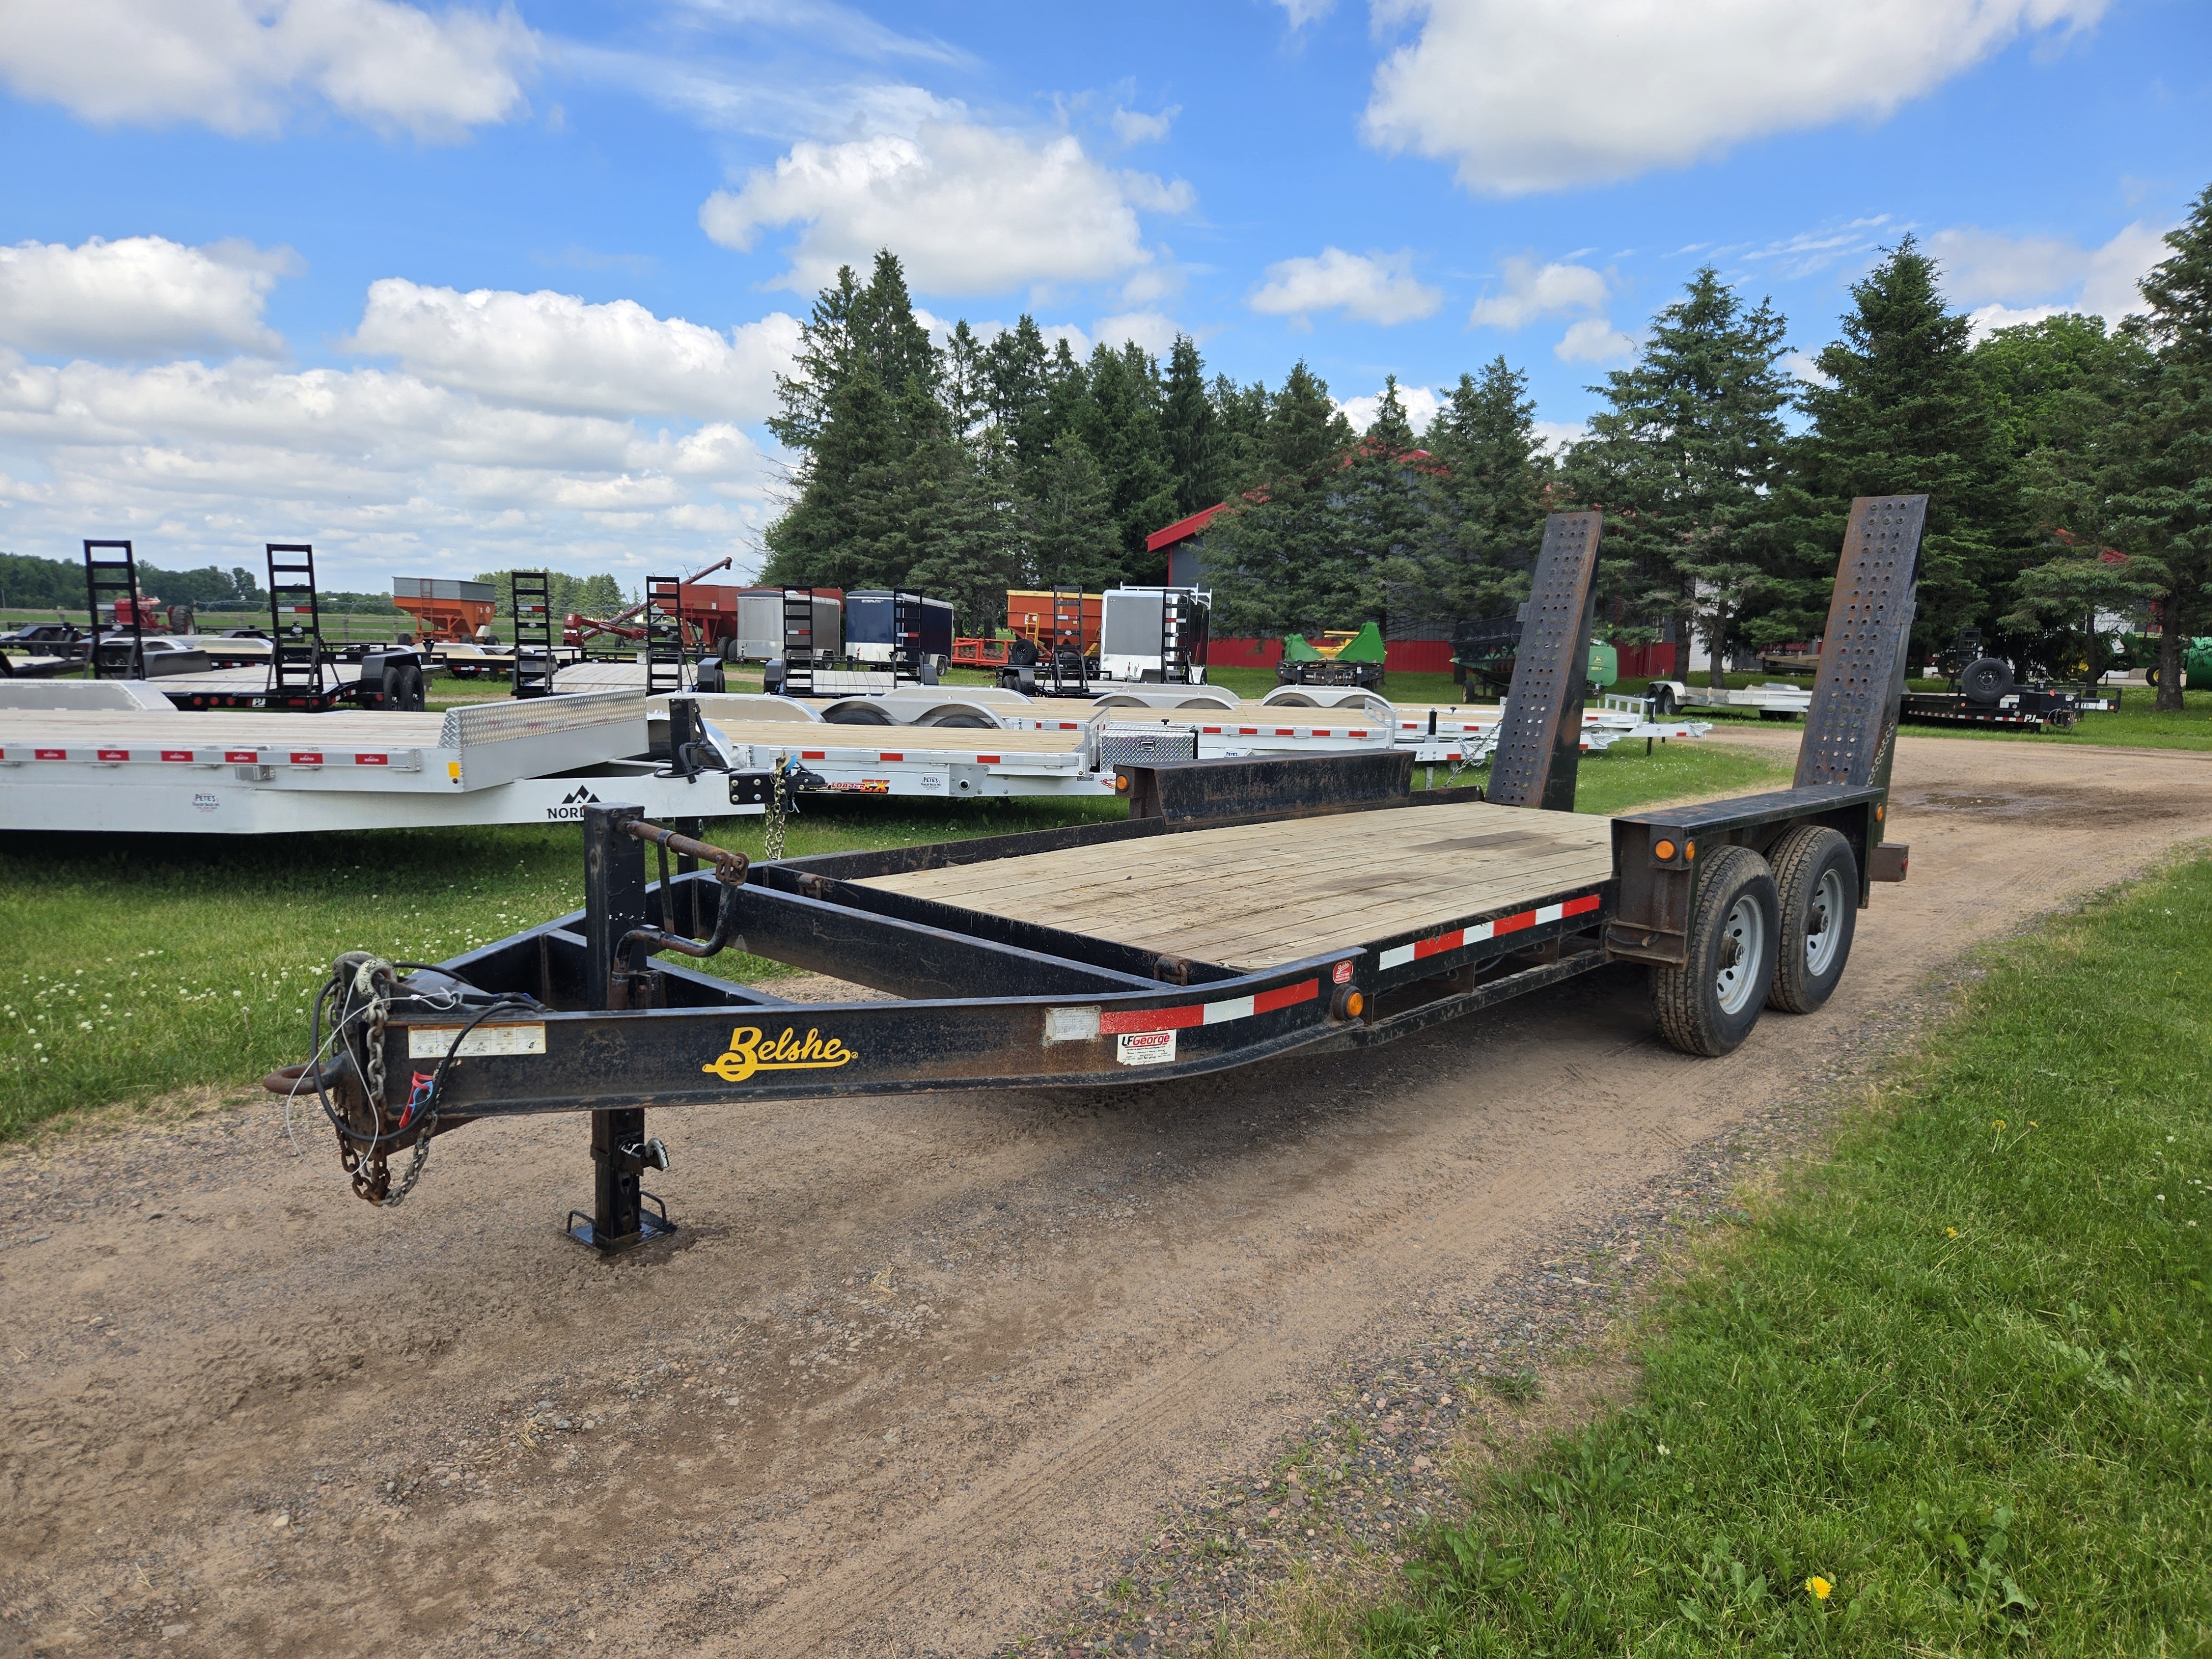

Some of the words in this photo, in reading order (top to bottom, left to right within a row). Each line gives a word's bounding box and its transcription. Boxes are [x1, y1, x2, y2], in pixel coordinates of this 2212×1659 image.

[2024, 714, 2036, 722] PJ
[860, 779, 890, 792] EX
[702, 1026, 852, 1082] Belshe
